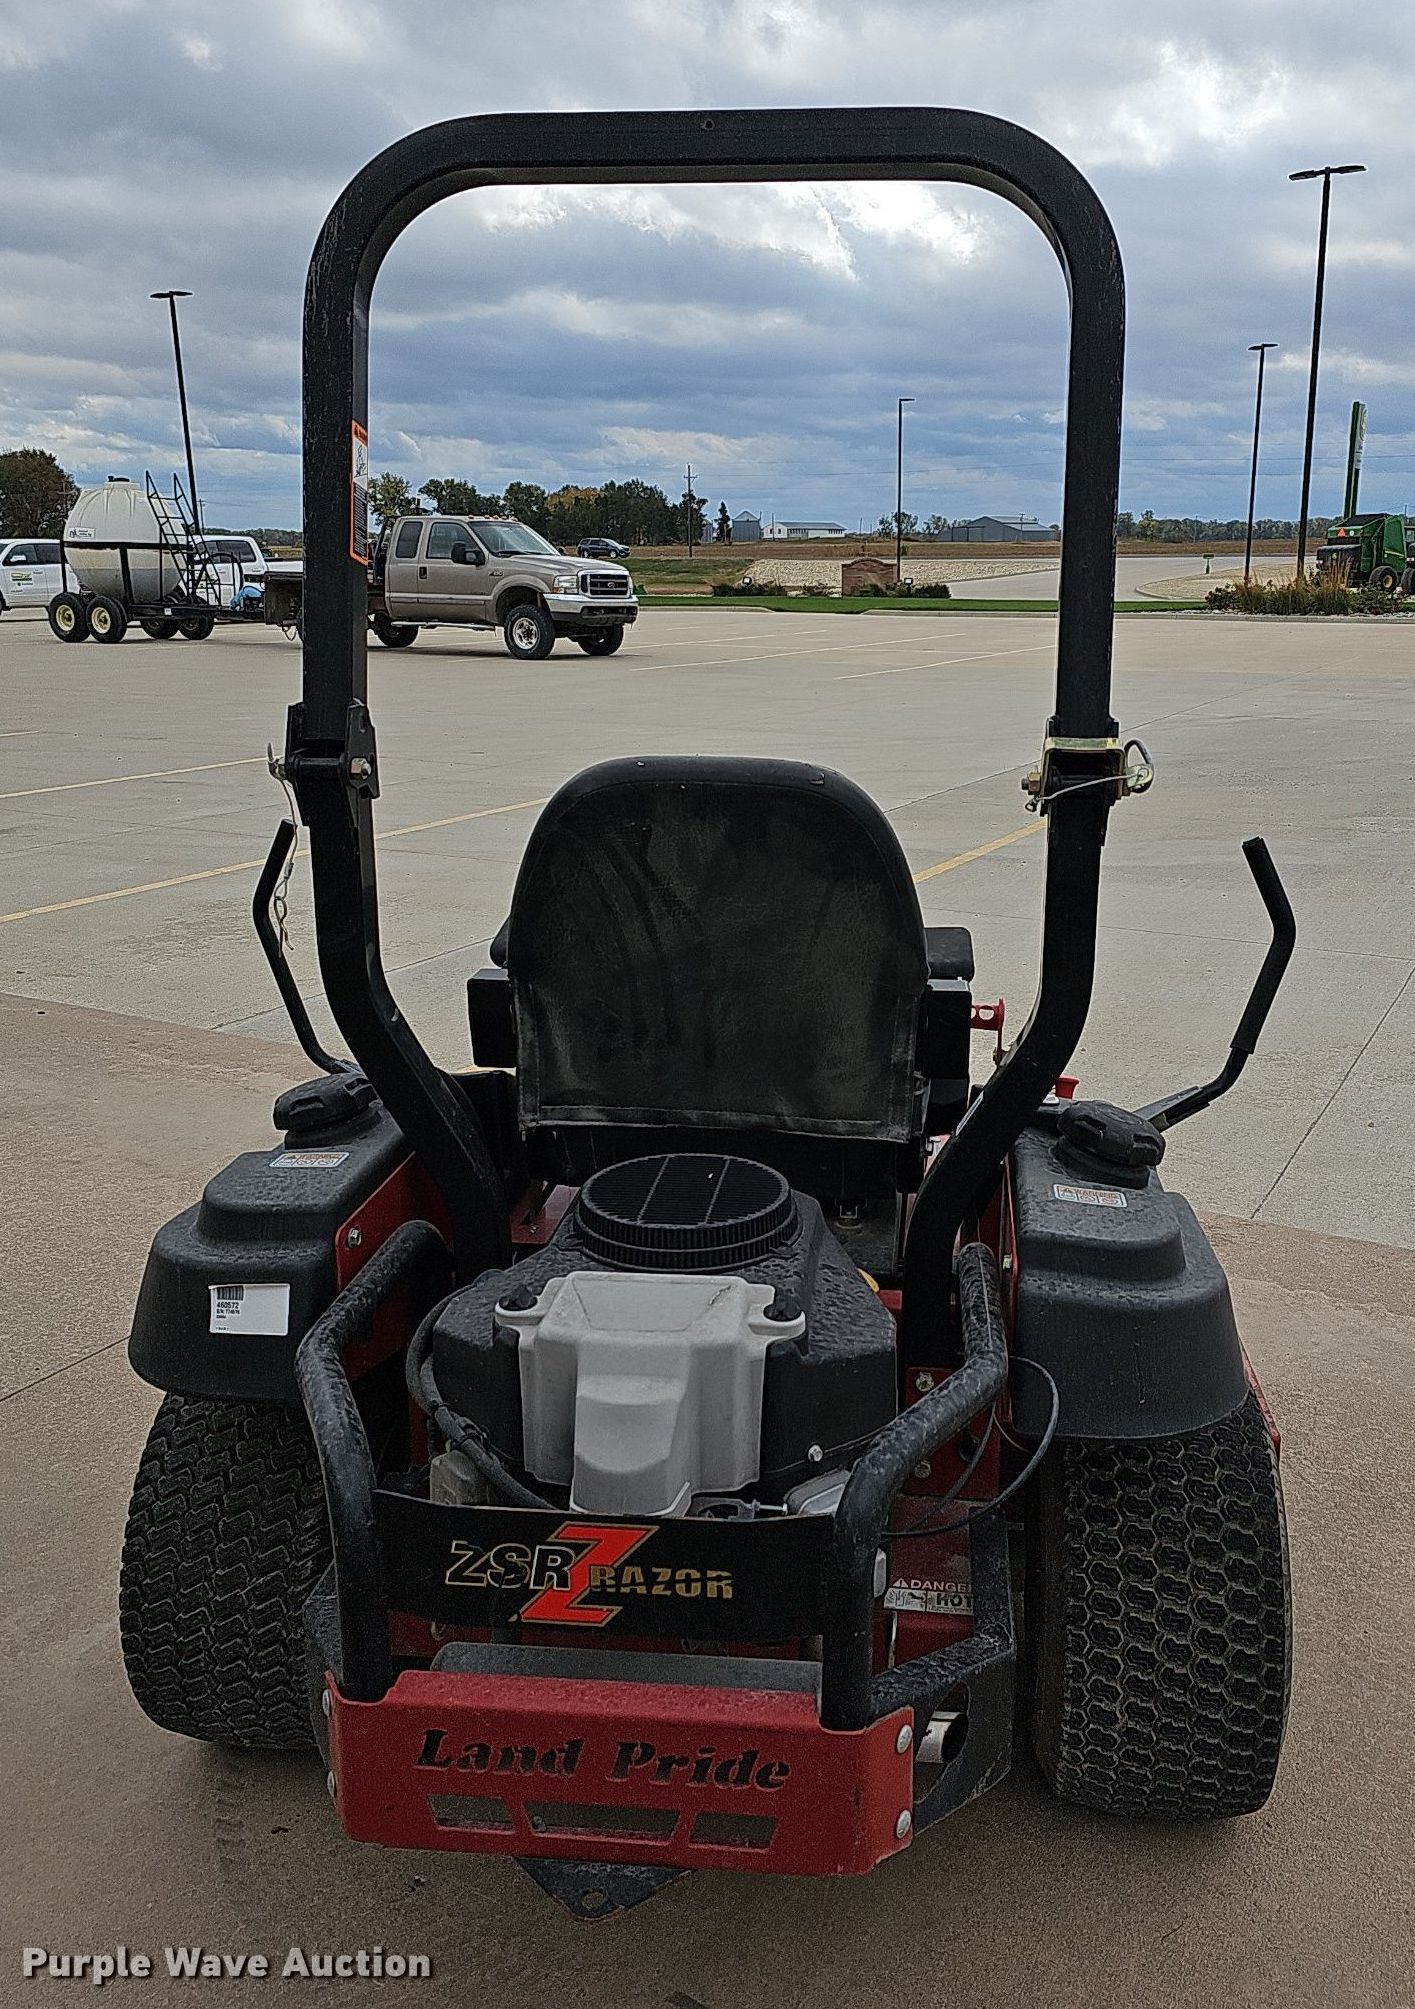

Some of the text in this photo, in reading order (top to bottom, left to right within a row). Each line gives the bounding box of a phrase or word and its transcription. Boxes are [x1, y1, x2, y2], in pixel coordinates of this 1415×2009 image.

[445, 1540, 577, 1591] ZSR
[590, 1565, 734, 1600] RAZOR
[910, 1579, 972, 1593] DANGE
[412, 1728, 792, 1792] Land Pride
